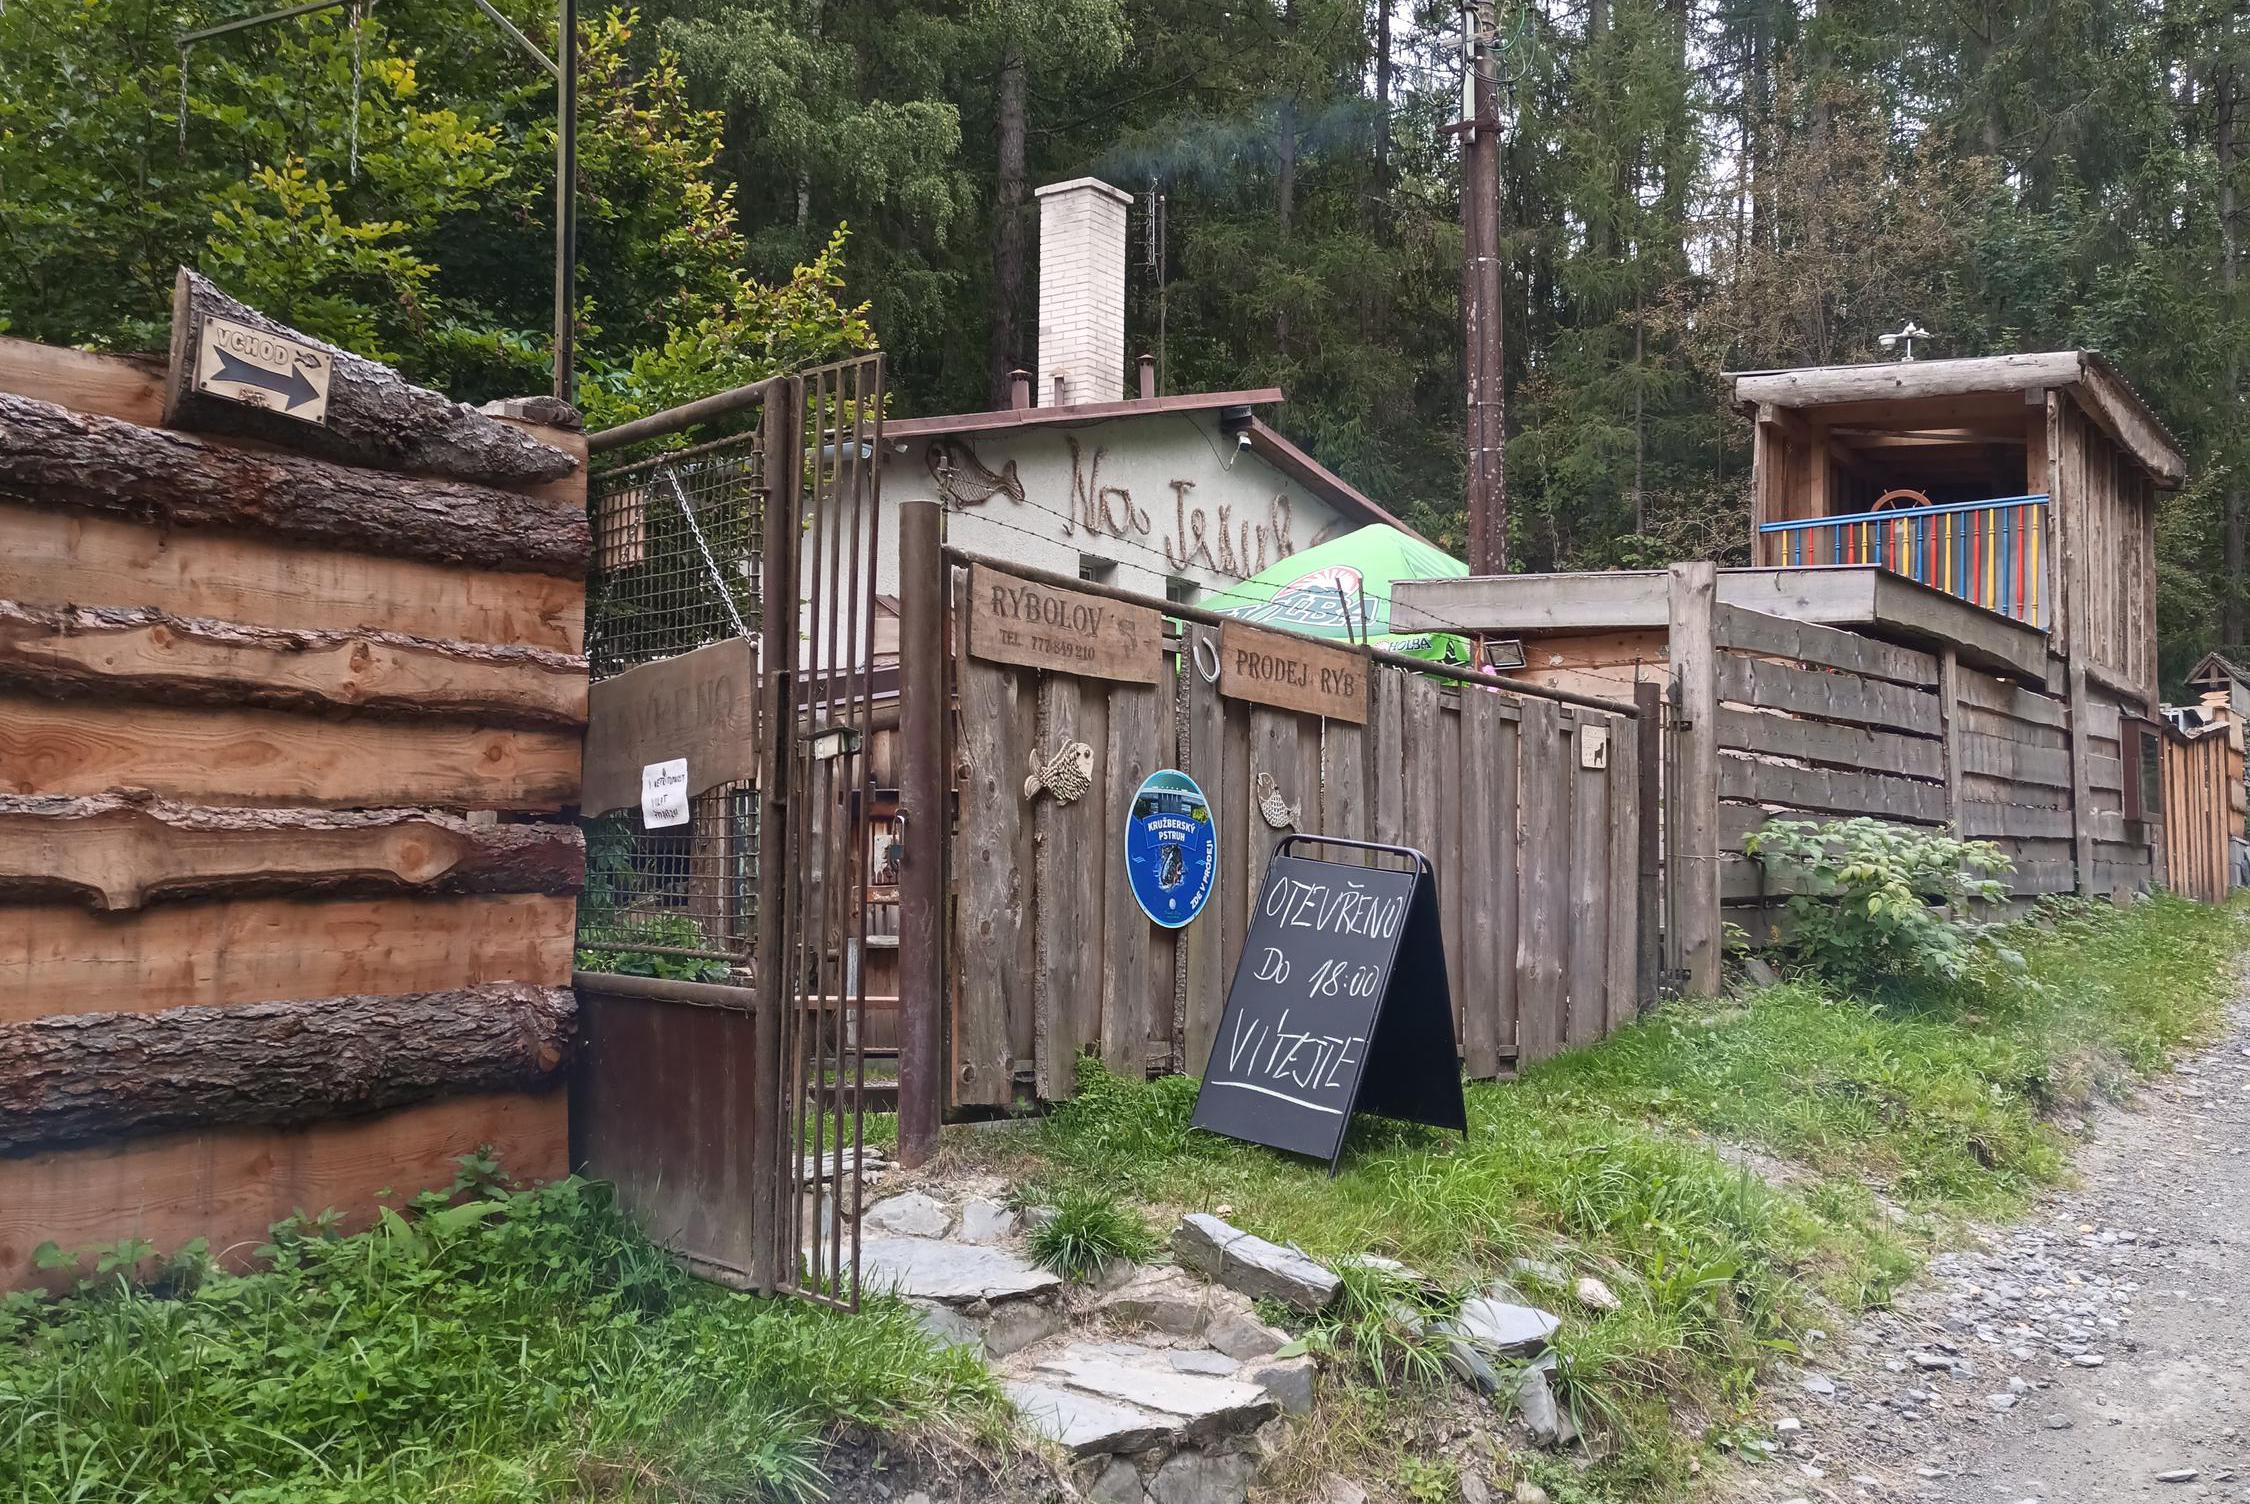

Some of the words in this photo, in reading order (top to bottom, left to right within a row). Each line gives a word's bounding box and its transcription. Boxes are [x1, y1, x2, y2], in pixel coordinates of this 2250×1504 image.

[217, 327, 289, 366] VCHOD
[1062, 434, 1151, 537] Na
[992, 586, 1103, 637] RYBOLOV
[1388, 637, 1432, 652] HOLBA
[1235, 648, 1307, 688] PRODEJ
[1321, 666, 1355, 698] RYB
[1147, 816, 1196, 835] KRUŽBERSKÝ
[1158, 830, 1186, 842] PSTRUH
[1189, 890, 1203, 910] ZDE
[1266, 876, 1403, 939] OTEVŘENO
[1308, 959, 1380, 998] 18:00
